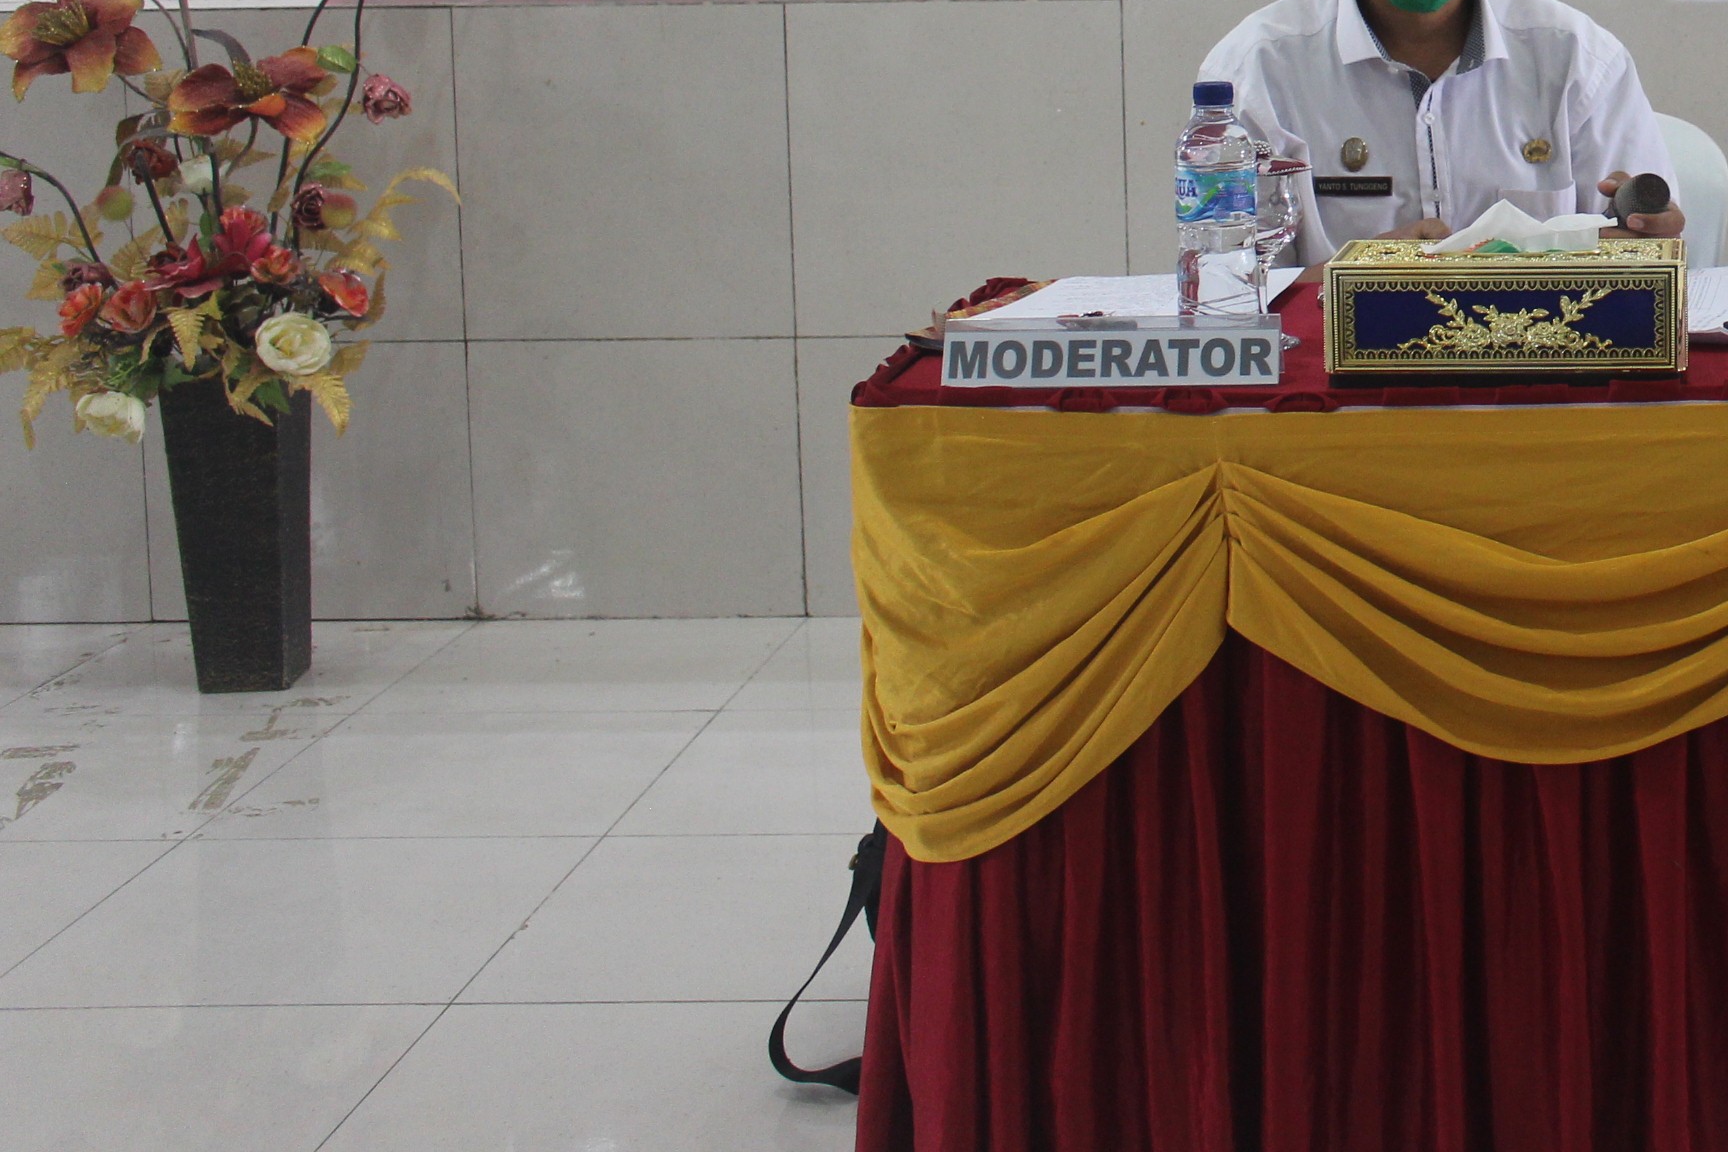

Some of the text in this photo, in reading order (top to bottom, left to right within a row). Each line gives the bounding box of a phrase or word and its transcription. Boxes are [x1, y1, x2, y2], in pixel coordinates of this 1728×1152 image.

[1176, 176, 1198, 199] UA
[1319, 182, 1340, 191] YANTO
[947, 338, 1273, 379] MODERATOR
